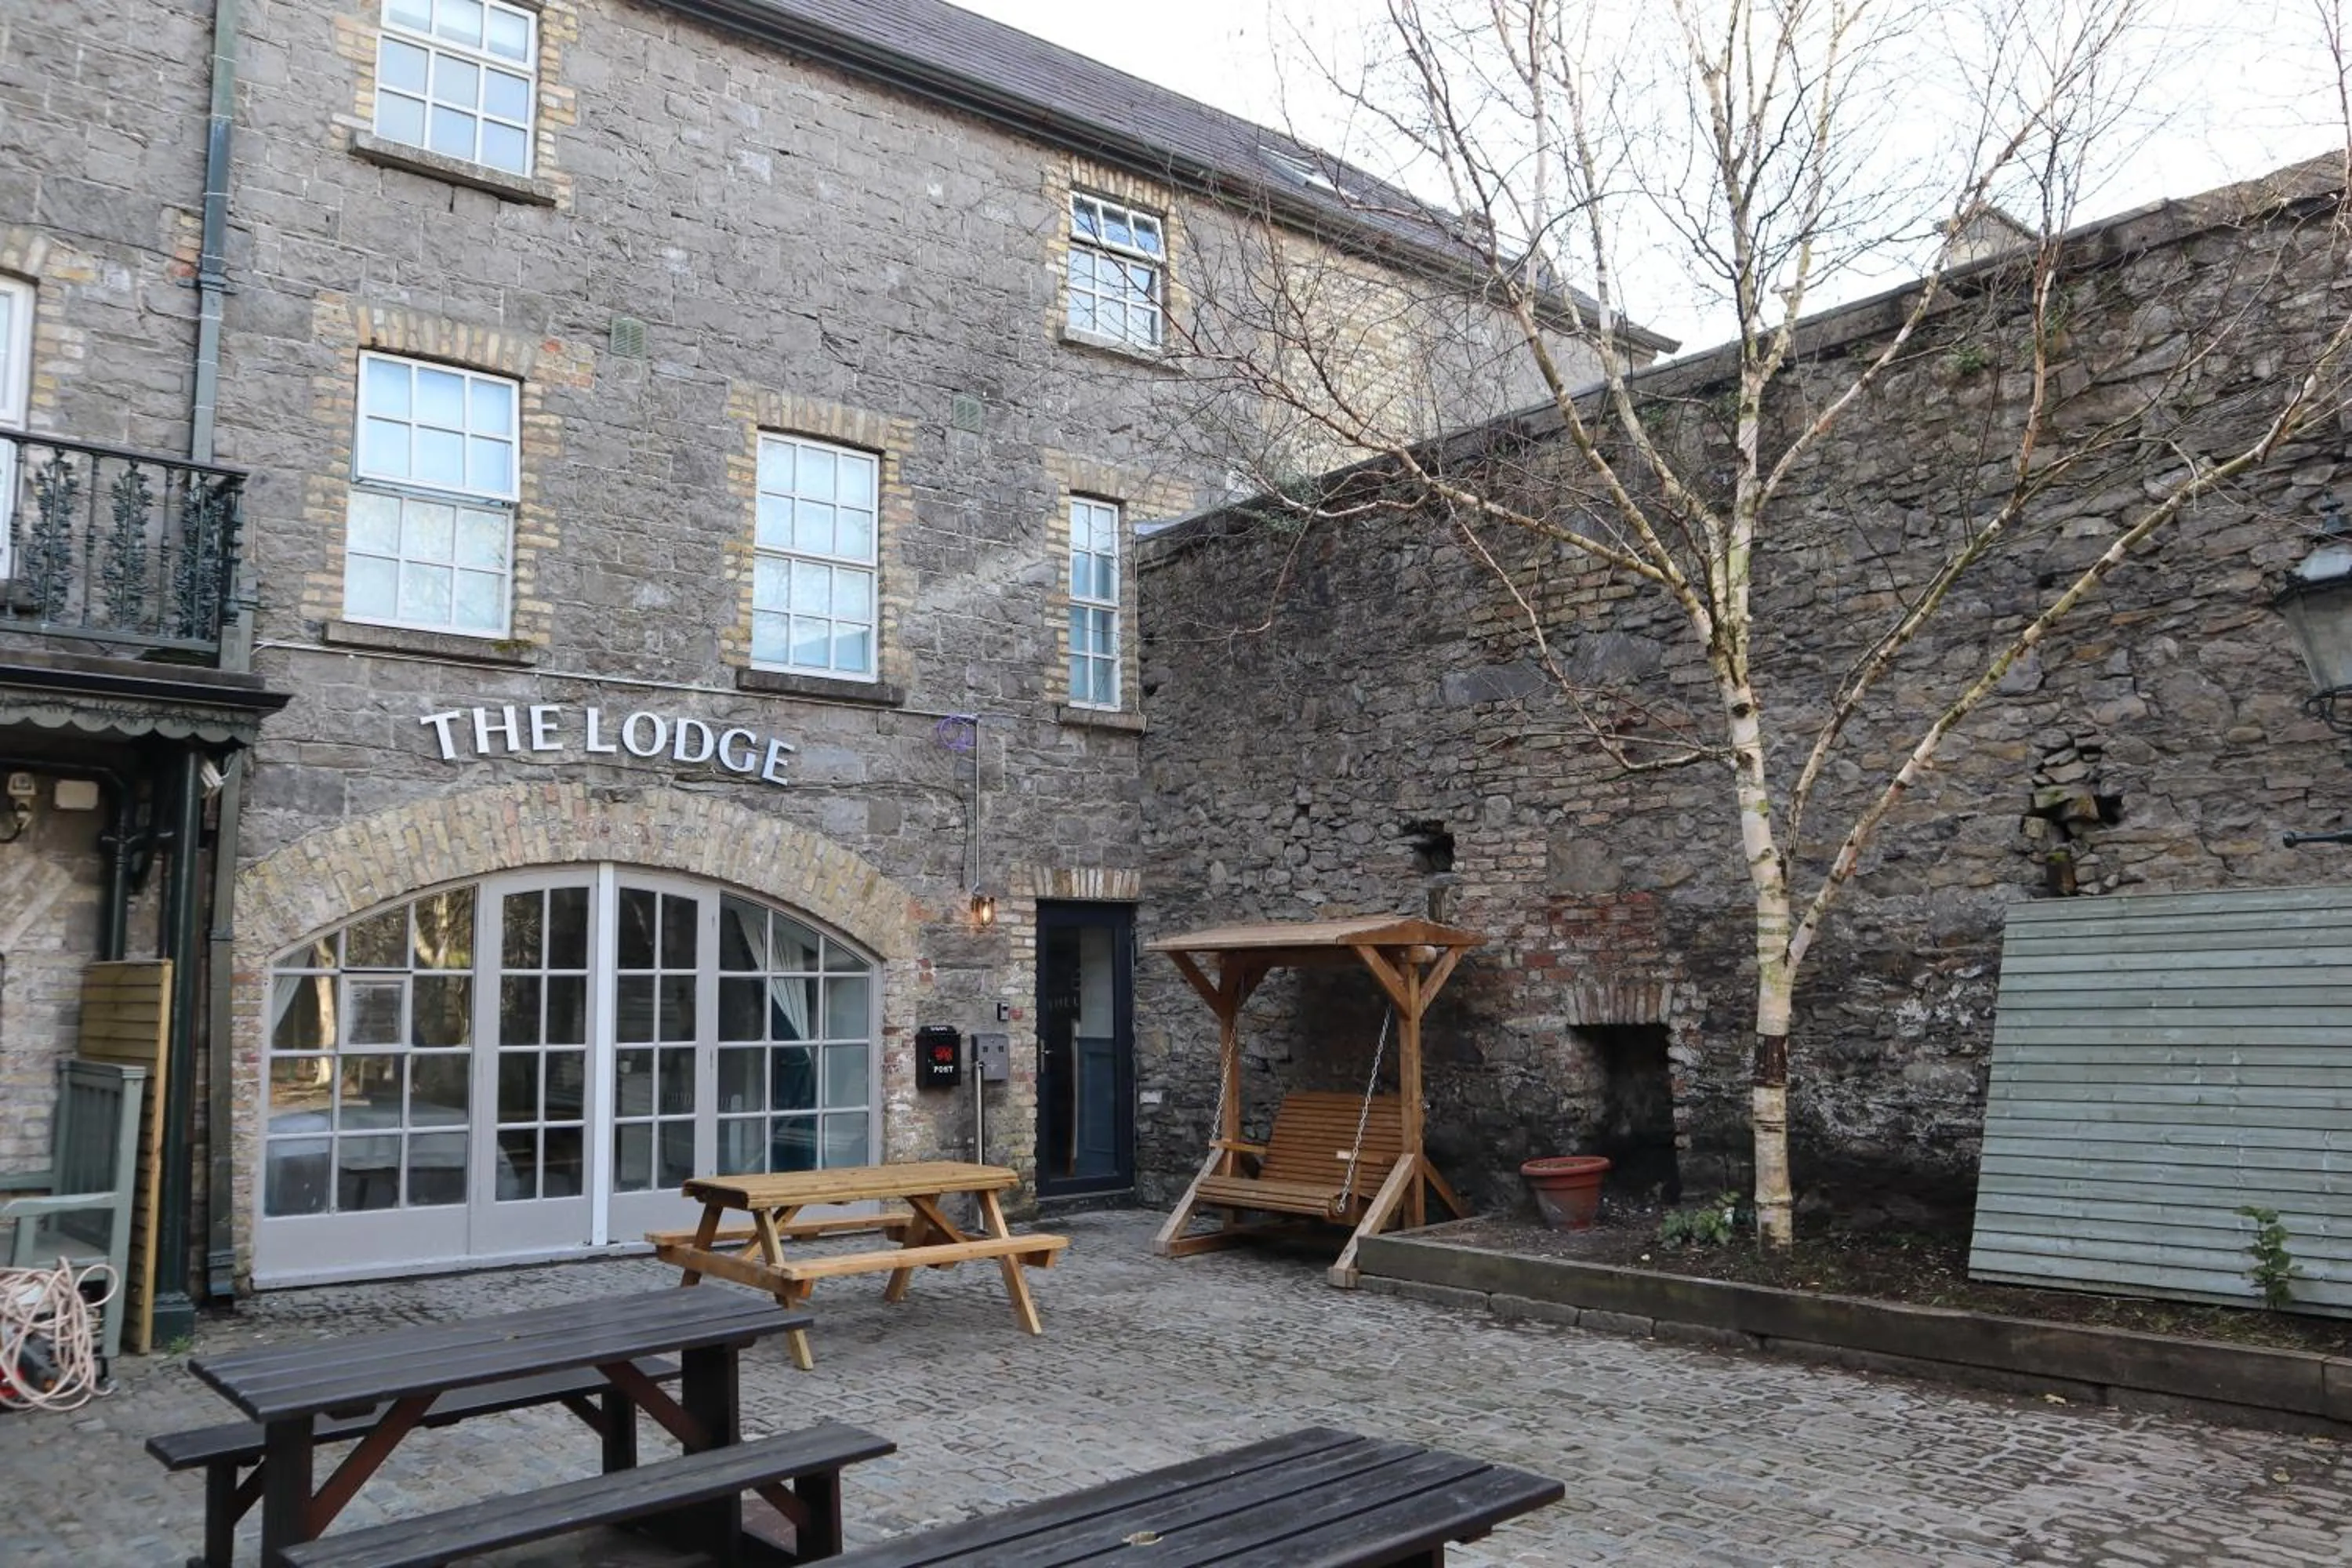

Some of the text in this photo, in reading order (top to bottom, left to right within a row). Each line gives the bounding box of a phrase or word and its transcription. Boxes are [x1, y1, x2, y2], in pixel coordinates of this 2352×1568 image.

[419, 705, 795, 785] THE LODGE
[933, 1065, 954, 1073] POST
